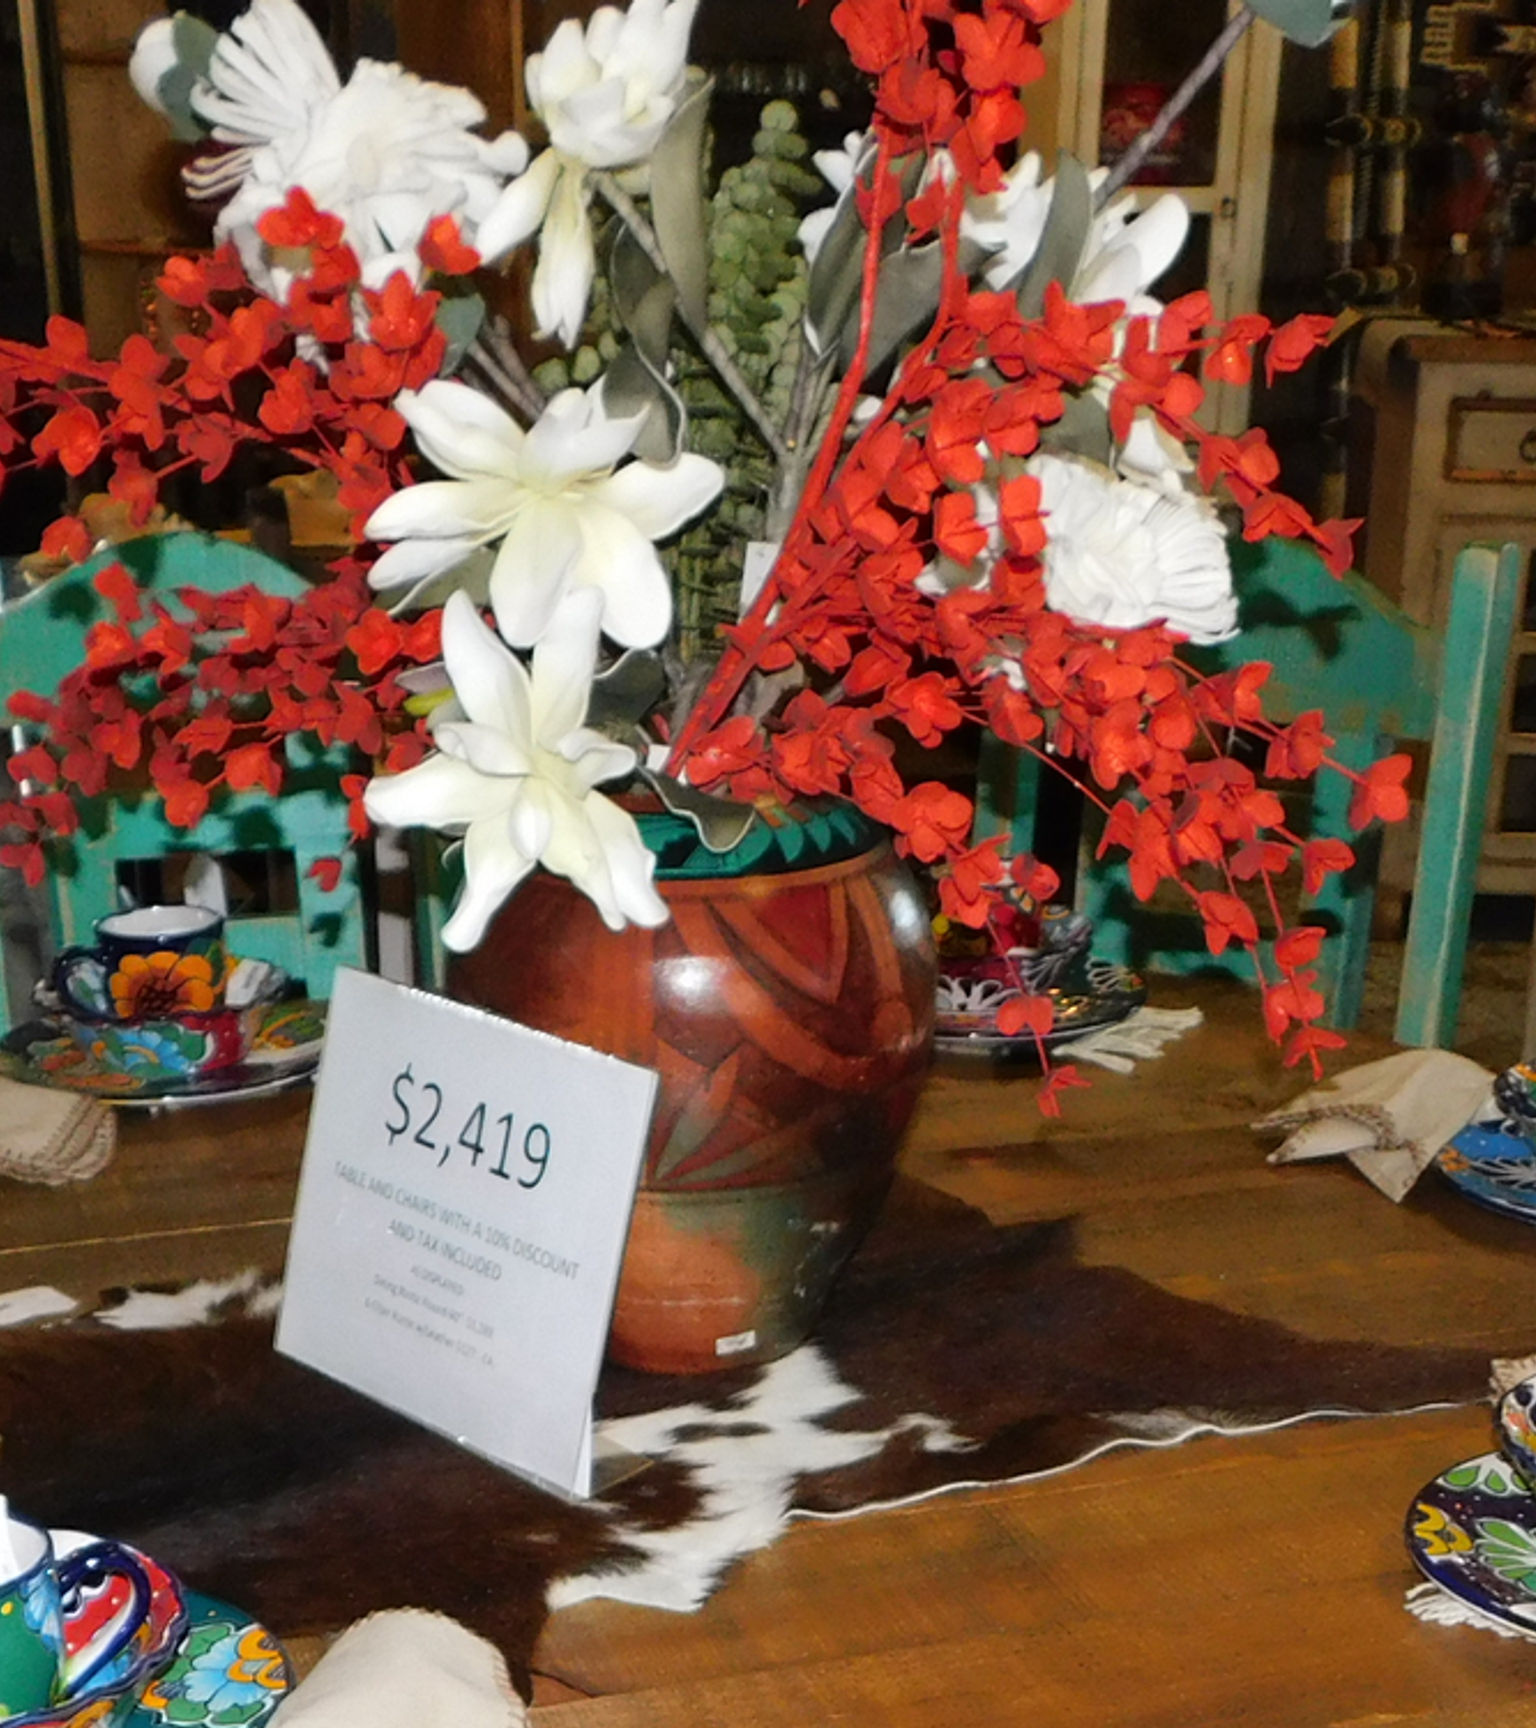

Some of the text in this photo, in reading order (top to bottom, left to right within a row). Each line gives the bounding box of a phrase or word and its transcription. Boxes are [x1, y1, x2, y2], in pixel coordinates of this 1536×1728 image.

[385, 1062, 552, 1190] $2,419
[335, 1160, 580, 1280] TABLE AND CHAIRS WITH A 10% DISCOUNT
[387, 1218, 415, 1243] AND
[417, 1229, 439, 1254] TAX
[441, 1242, 503, 1281] INCLUDED
